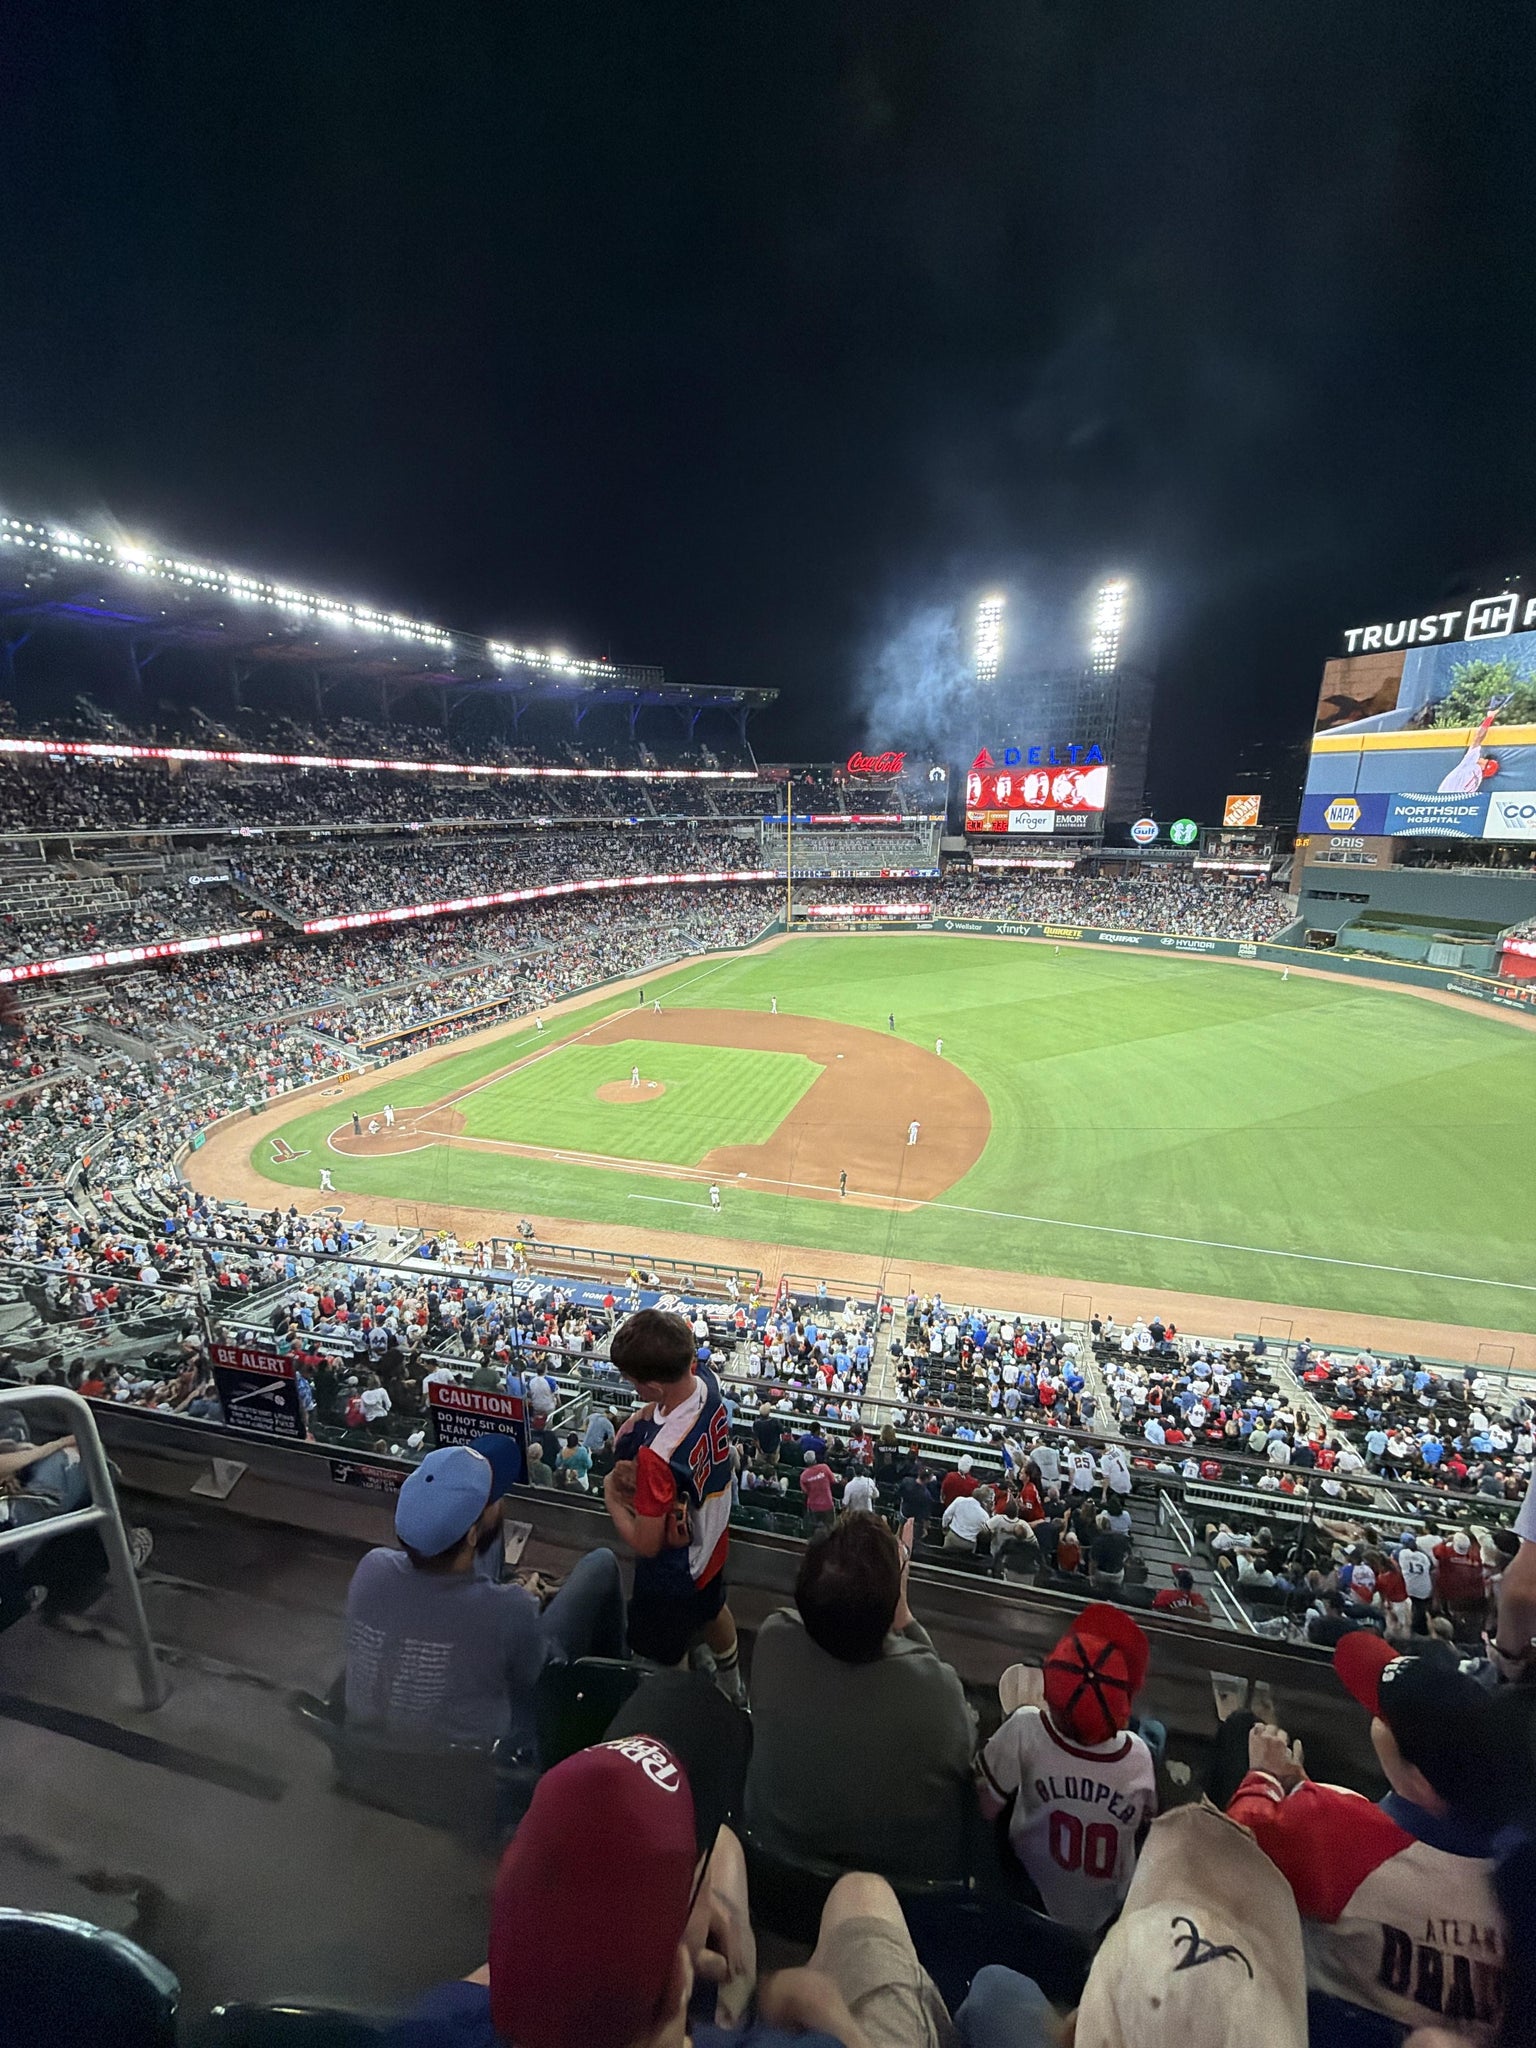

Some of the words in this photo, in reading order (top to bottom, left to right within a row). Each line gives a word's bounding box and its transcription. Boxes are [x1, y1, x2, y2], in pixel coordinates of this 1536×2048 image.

[1344, 611, 1462, 652] TRUIST
[1004, 744, 1104, 766] DELTA
[1225, 796, 1258, 825] HOME
[1330, 807, 1355, 821] NAPA
[1394, 806, 1480, 816] NORTHSIDE
[1015, 812, 1047, 830] Kroger
[1056, 815, 1088, 823] EMORY
[1407, 816, 1461, 824] HOSPITAL
[1134, 827, 1156, 835] Gulf
[1330, 837, 1364, 848] ORIS
[954, 922, 983, 931] Wellstar
[995, 924, 1031, 936] xfinity
[1043, 926, 1083, 937] QUIKRETE
[1099, 932, 1141, 944] EQUIFAX
[1175, 939, 1215, 949] HYUNDAI
[217, 1349, 237, 1365] BE
[242, 1353, 286, 1373] ALERT
[438, 1388, 513, 1415] CAUTION
[437, 1412, 453, 1422] DO
[455, 1415, 477, 1427] NOT
[480, 1420, 496, 1431] SIT
[440, 1423, 468, 1436] LEAN
[1074, 1457, 1090, 1469] 25
[1116, 1459, 1125, 1472] 1
[1050, 1809, 1119, 1879] 00
